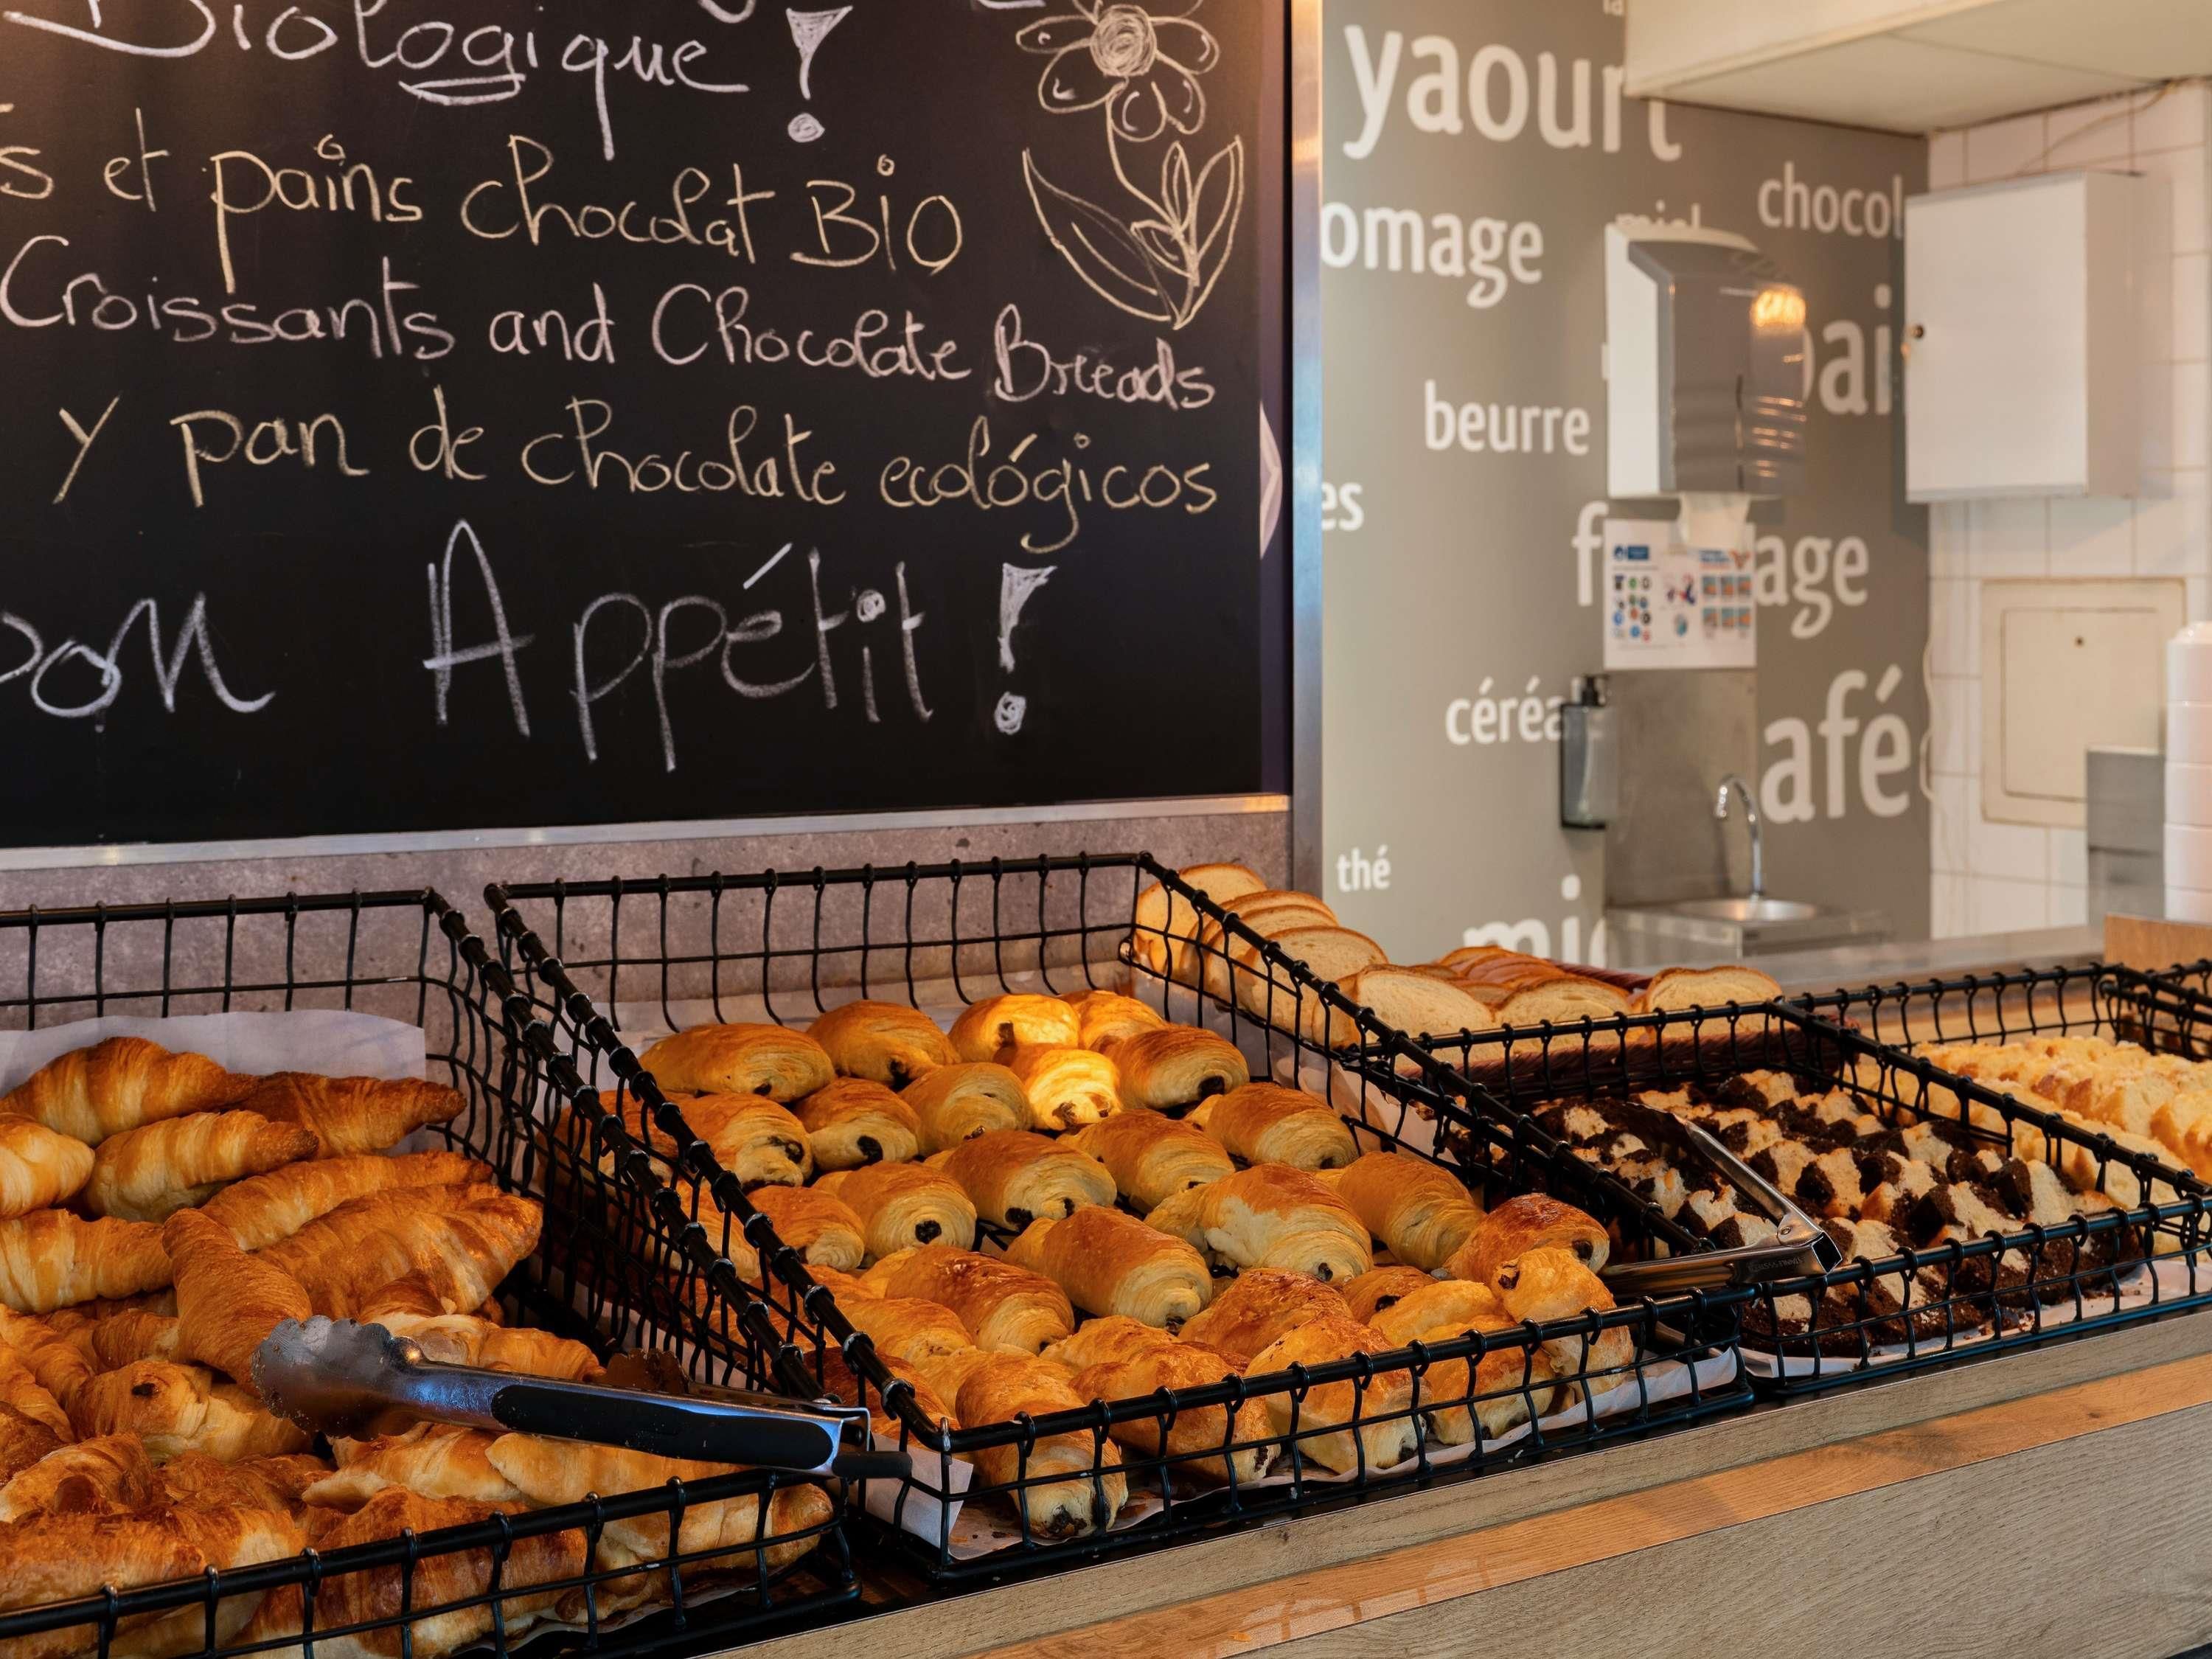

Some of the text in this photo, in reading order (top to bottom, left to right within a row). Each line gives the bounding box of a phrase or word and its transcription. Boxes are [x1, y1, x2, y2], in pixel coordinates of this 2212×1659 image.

[104, 108, 170, 212] et
[210, 134, 423, 293] pains
[461, 134, 775, 264] chocolat
[1321, 201, 1544, 308] omage
[0, 235, 1216, 410] Croissants and Chocolate Breads
[1803, 283, 1893, 416] ai
[170, 411, 369, 507] pan
[409, 384, 487, 481] de
[521, 397, 846, 506] chocolate
[880, 415, 1218, 554] ecológicos
[1425, 380, 1590, 456] beurre
[422, 518, 933, 773] Appétit
[1337, 846, 1391, 891] thé
